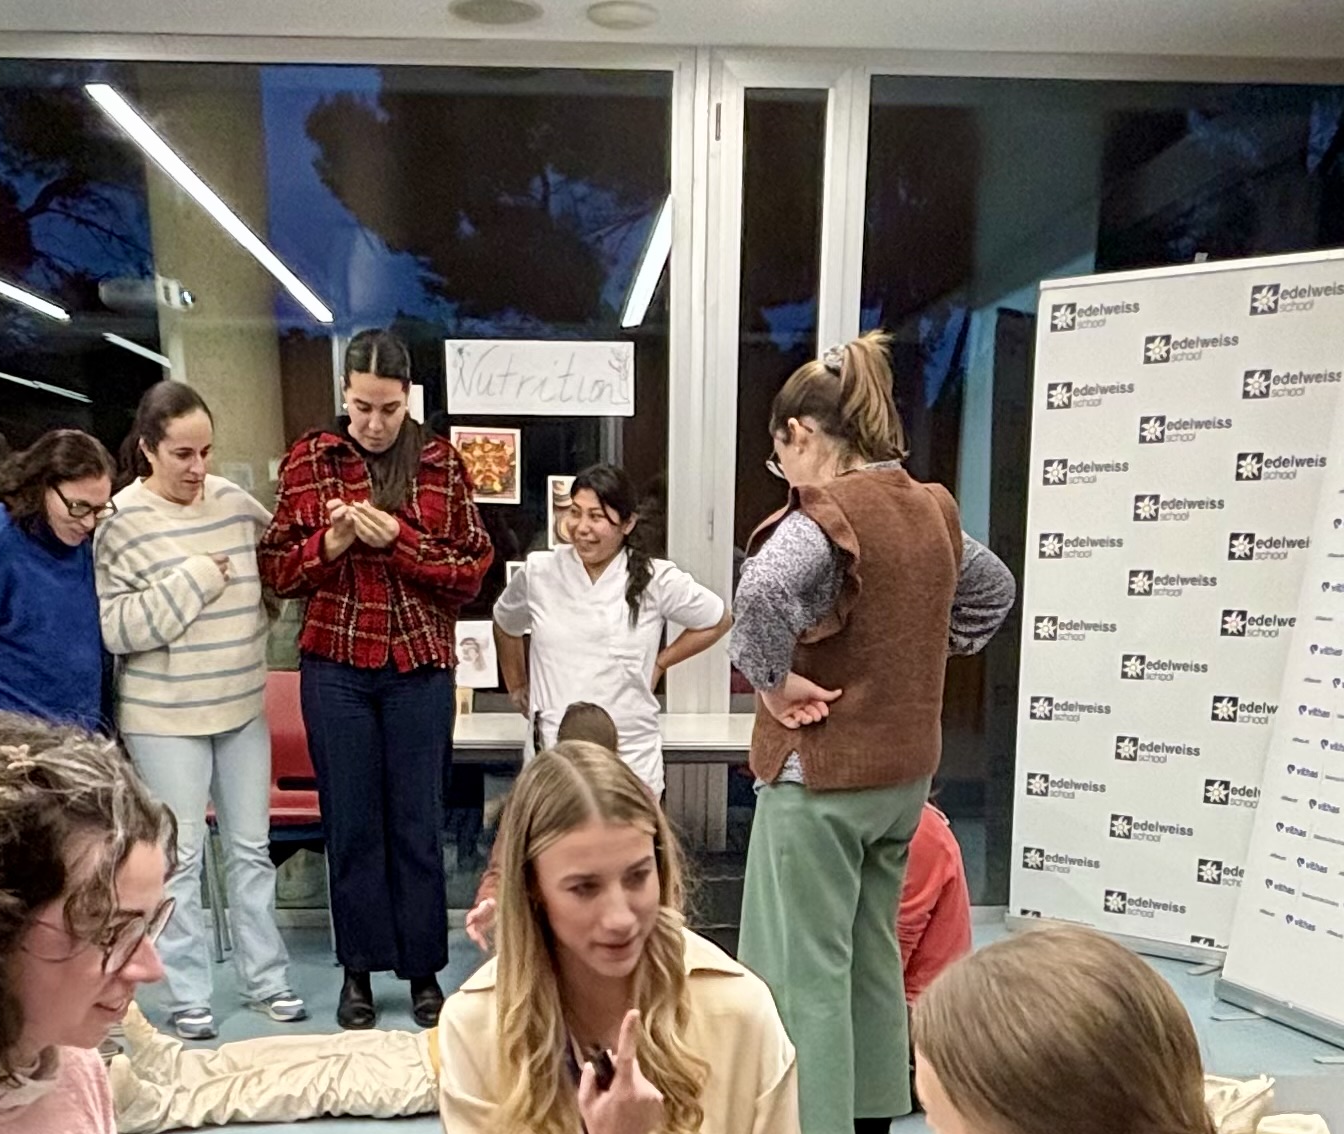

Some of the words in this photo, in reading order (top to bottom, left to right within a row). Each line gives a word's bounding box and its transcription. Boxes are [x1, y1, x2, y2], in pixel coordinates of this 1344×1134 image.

[1077, 301, 1140, 318] edelweiss
[1280, 300, 1314, 312] school
[1077, 318, 1106, 329] school
[1172, 334, 1239, 350] edelweiss
[1171, 350, 1202, 361] school
[452, 344, 616, 404] Nutrition
[1073, 382, 1134, 397] edelweiss
[1272, 386, 1305, 398] school
[1073, 398, 1102, 408] school
[1166, 417, 1232, 431] edelweiss
[1166, 432, 1196, 442] school
[1264, 454, 1327, 468] edelweis
[1068, 461, 1129, 474] edelweiss
[1068, 474, 1097, 484] school
[1263, 470, 1297, 481] school
[1161, 498, 1225, 510] edelweiss
[1160, 511, 1189, 521] school
[1064, 536, 1124, 548] edelweiss
[1256, 536, 1310, 549] edelwei
[1064, 549, 1092, 559] school
[1255, 551, 1288, 561] school
[1154, 574, 1217, 586] edelweiss
[1154, 588, 1182, 597] school
[1058, 619, 1117, 632] edelweiss
[1248, 614, 1297, 628] edelwe
[1058, 632, 1085, 641] school
[1247, 628, 1279, 638] school
[1146, 659, 1208, 673] edelweiss
[1146, 672, 1174, 681] school
[1054, 702, 1111, 715] edelweiss
[1239, 702, 1278, 714] edelw
[1054, 712, 1080, 722] school
[1238, 715, 1268, 725] school
[1139, 741, 1201, 757] edelweiss
[1138, 752, 1167, 764] school
[1050, 778, 1106, 793] edelweiss
[1050, 789, 1075, 799] school
[1134, 820, 1194, 836] edelweiss
[1133, 831, 1161, 842] school
[1045, 852, 1100, 869] edelweiss
[1045, 864, 1070, 874] school
[1128, 896, 1186, 914] edelweiss
[1127, 907, 1154, 919] school
